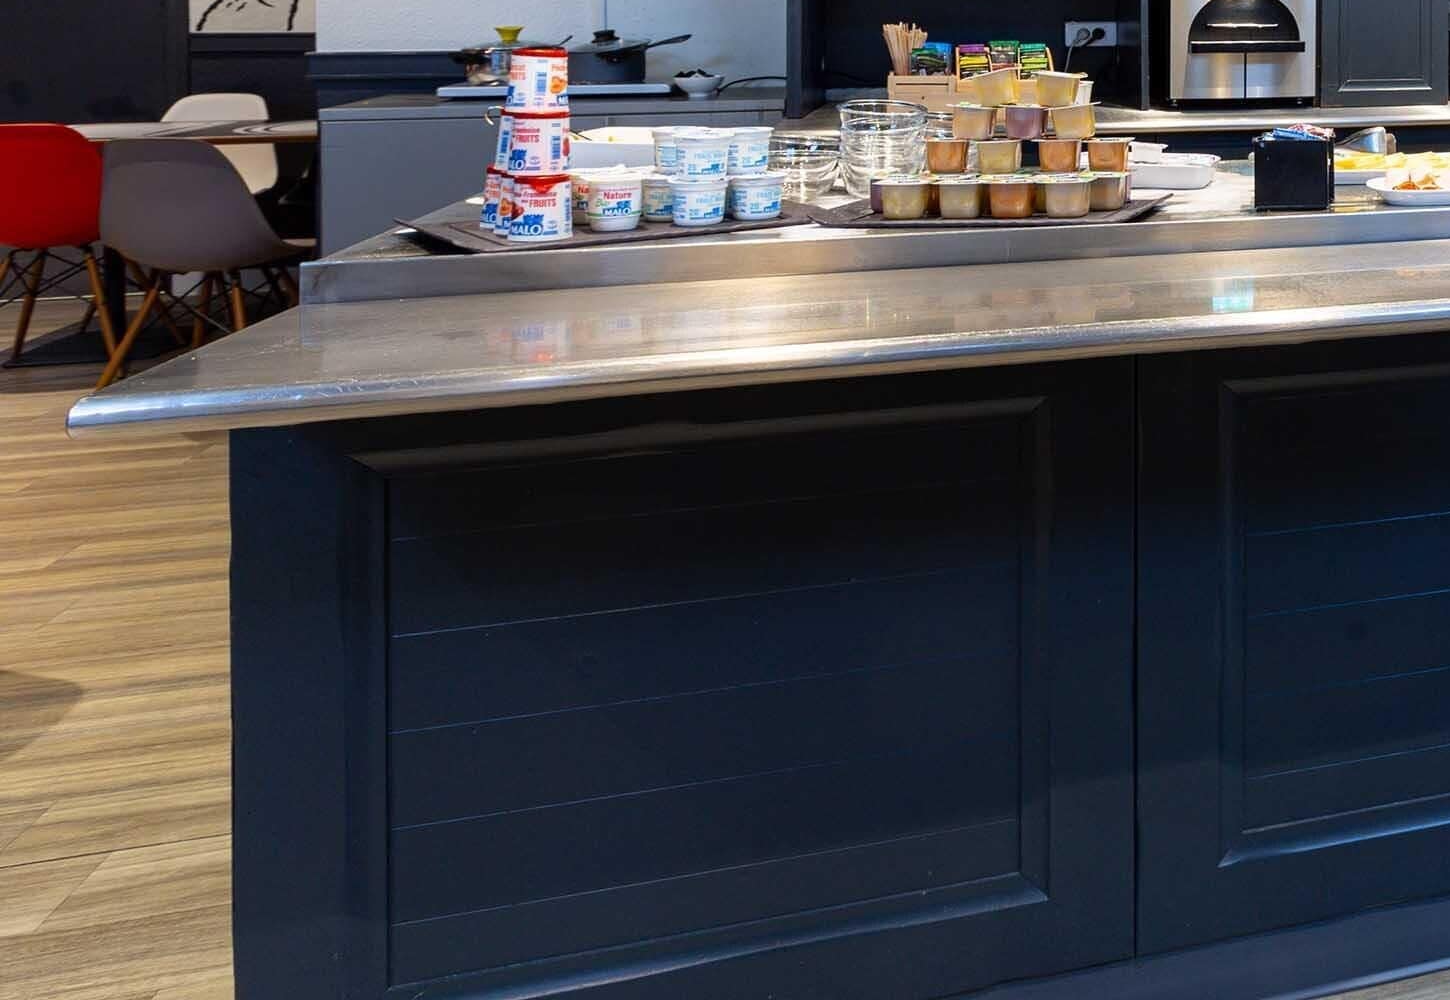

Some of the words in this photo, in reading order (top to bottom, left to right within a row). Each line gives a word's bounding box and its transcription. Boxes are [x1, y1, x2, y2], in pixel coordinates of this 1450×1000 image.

[603, 191, 633, 201] Nature
[529, 198, 557, 208] FRUITS
[605, 207, 631, 217] MALO
[511, 223, 542, 236] MALO
